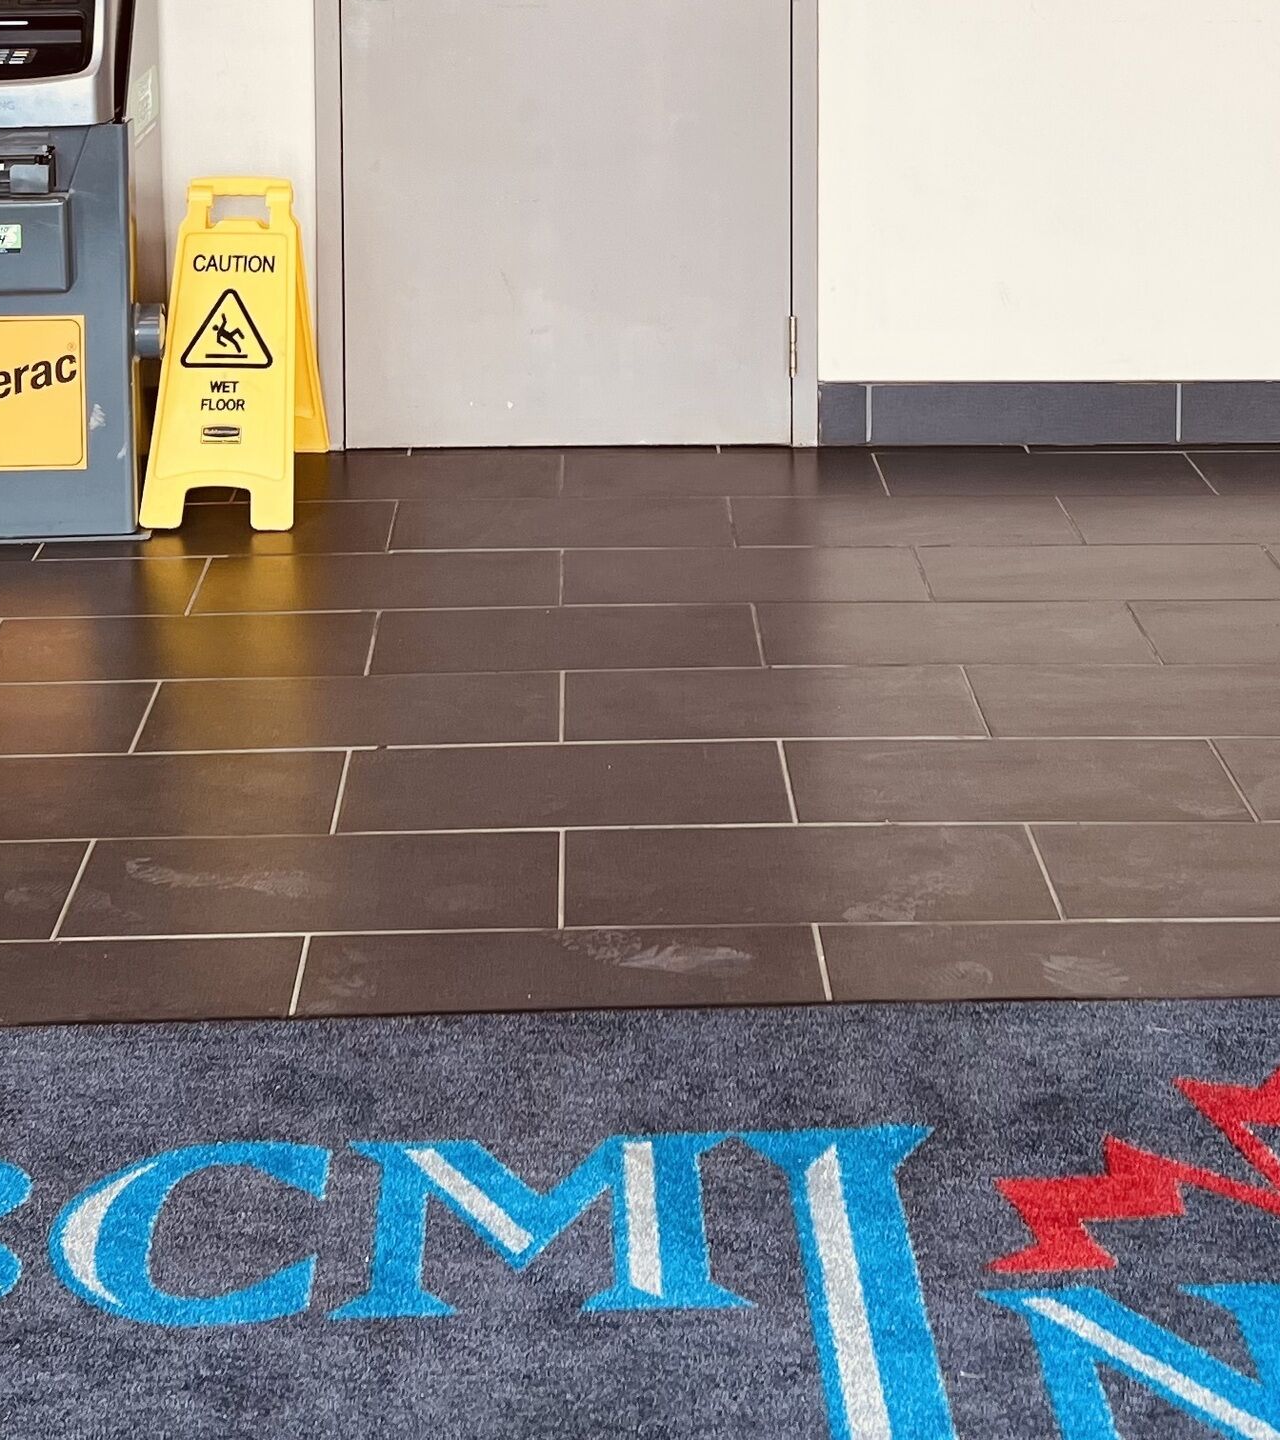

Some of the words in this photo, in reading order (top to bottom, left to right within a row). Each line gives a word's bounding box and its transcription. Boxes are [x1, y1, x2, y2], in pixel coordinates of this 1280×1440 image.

[193, 254, 276, 273] CAUTION
[210, 380, 239, 394] WET
[201, 398, 245, 412] FLOOR
